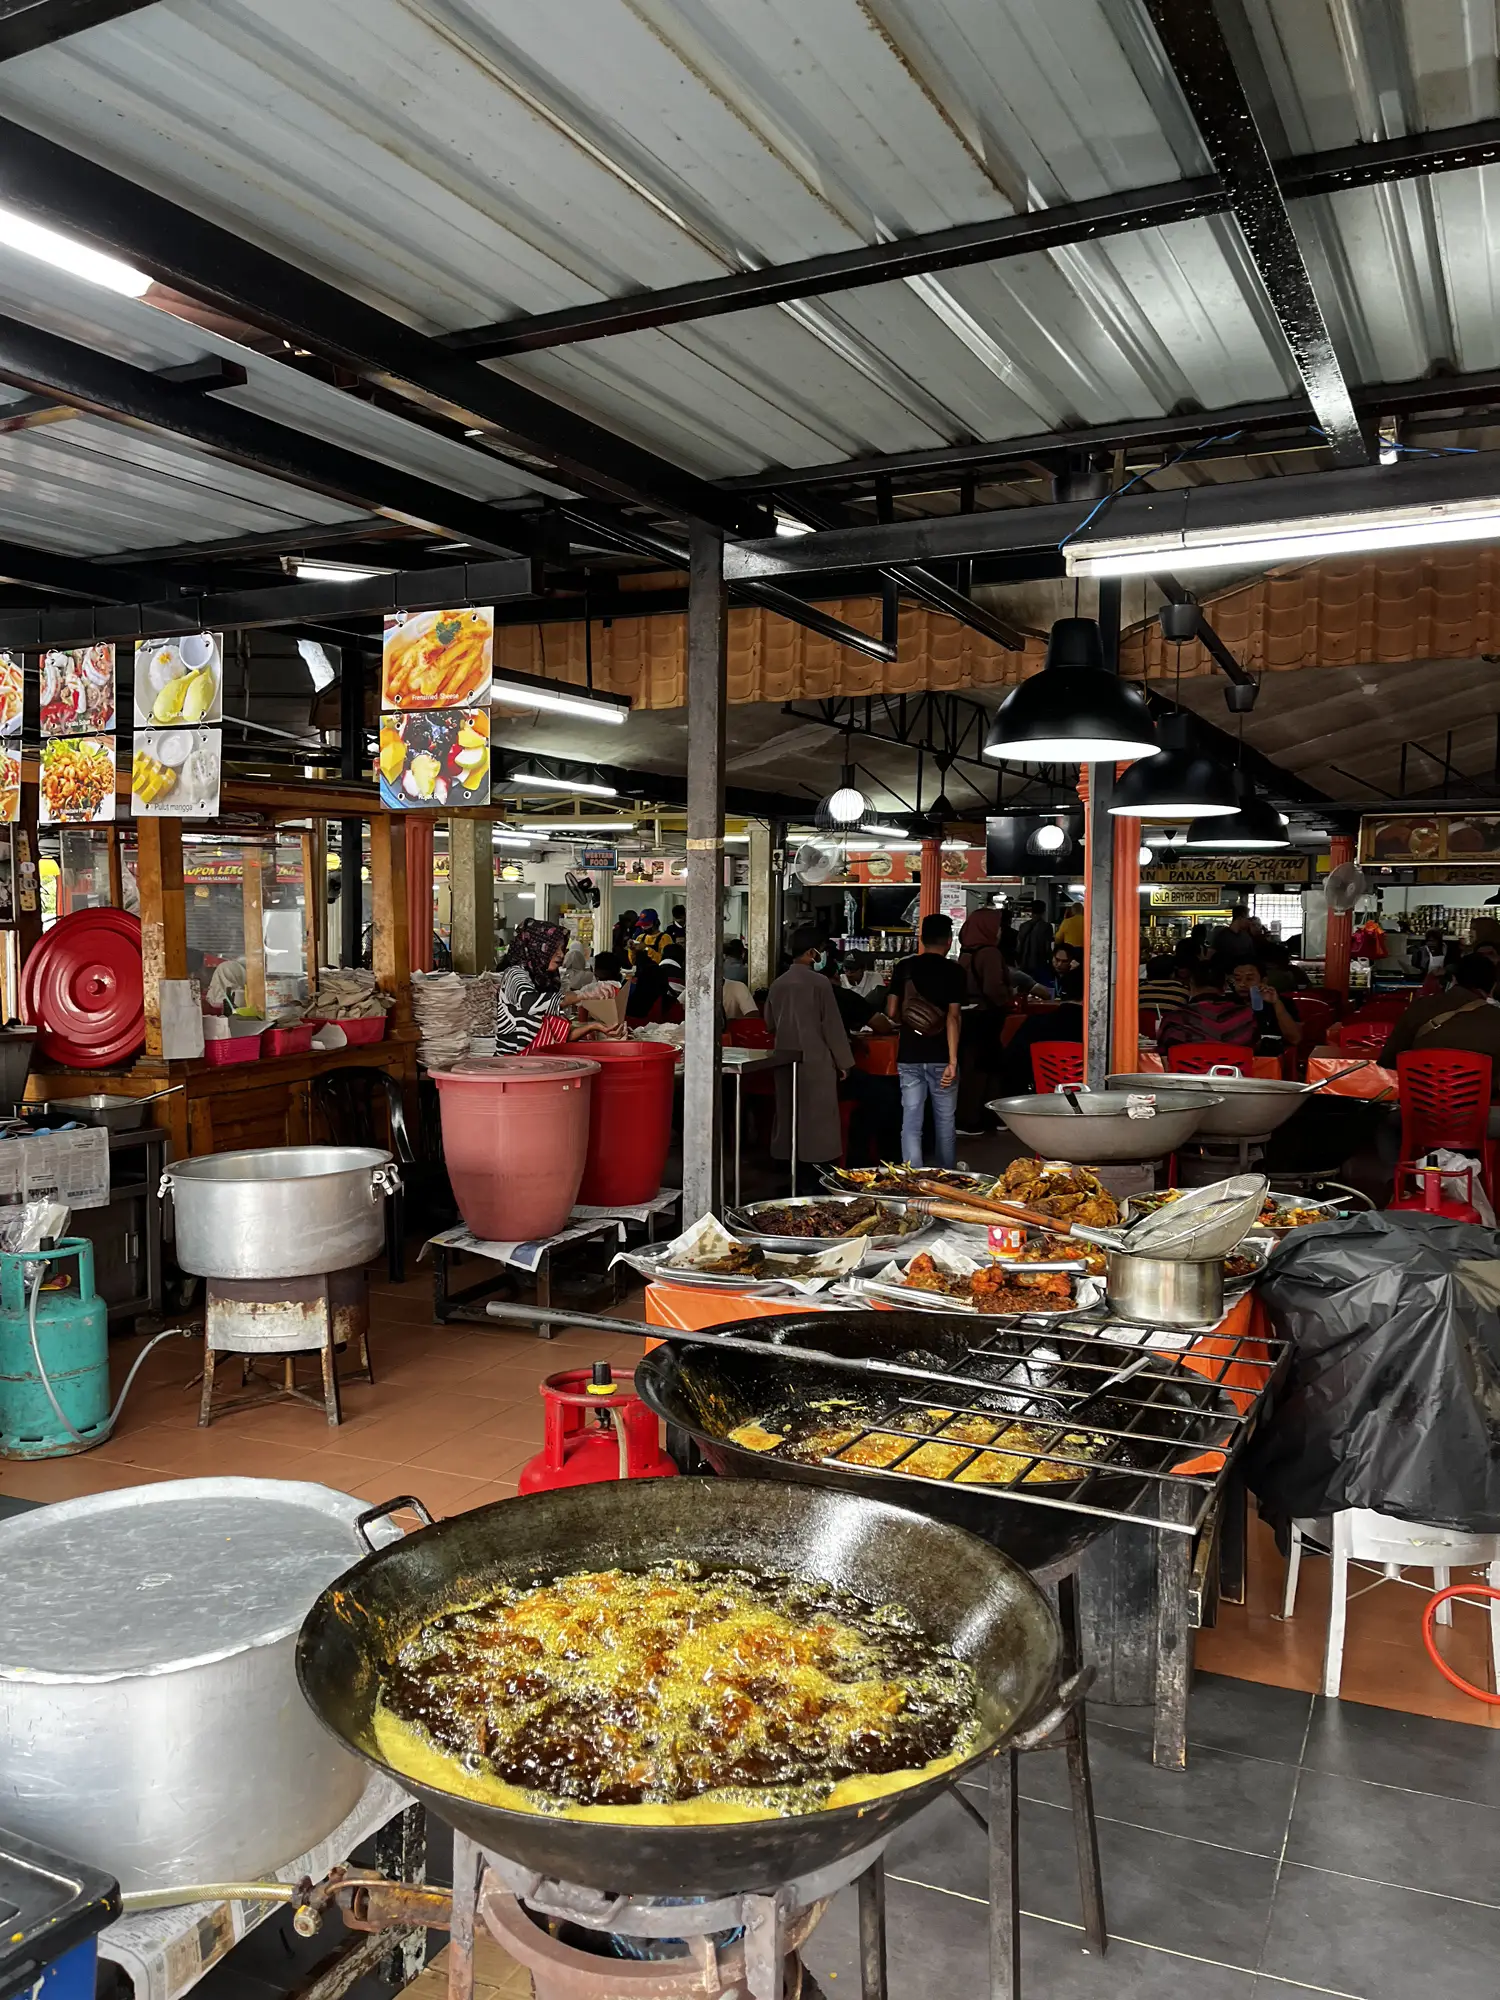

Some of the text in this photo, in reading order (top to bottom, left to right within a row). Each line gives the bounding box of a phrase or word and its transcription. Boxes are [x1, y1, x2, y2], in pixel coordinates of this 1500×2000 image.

[154, 803, 193, 812] Pulut mangga
[584, 851, 614, 859] WESTERN
[1168, 870, 1216, 881] PANAS
[1227, 870, 1255, 881] ALA
[1154, 891, 1169, 902] SILA
[1171, 891, 1195, 902] BAYAR
